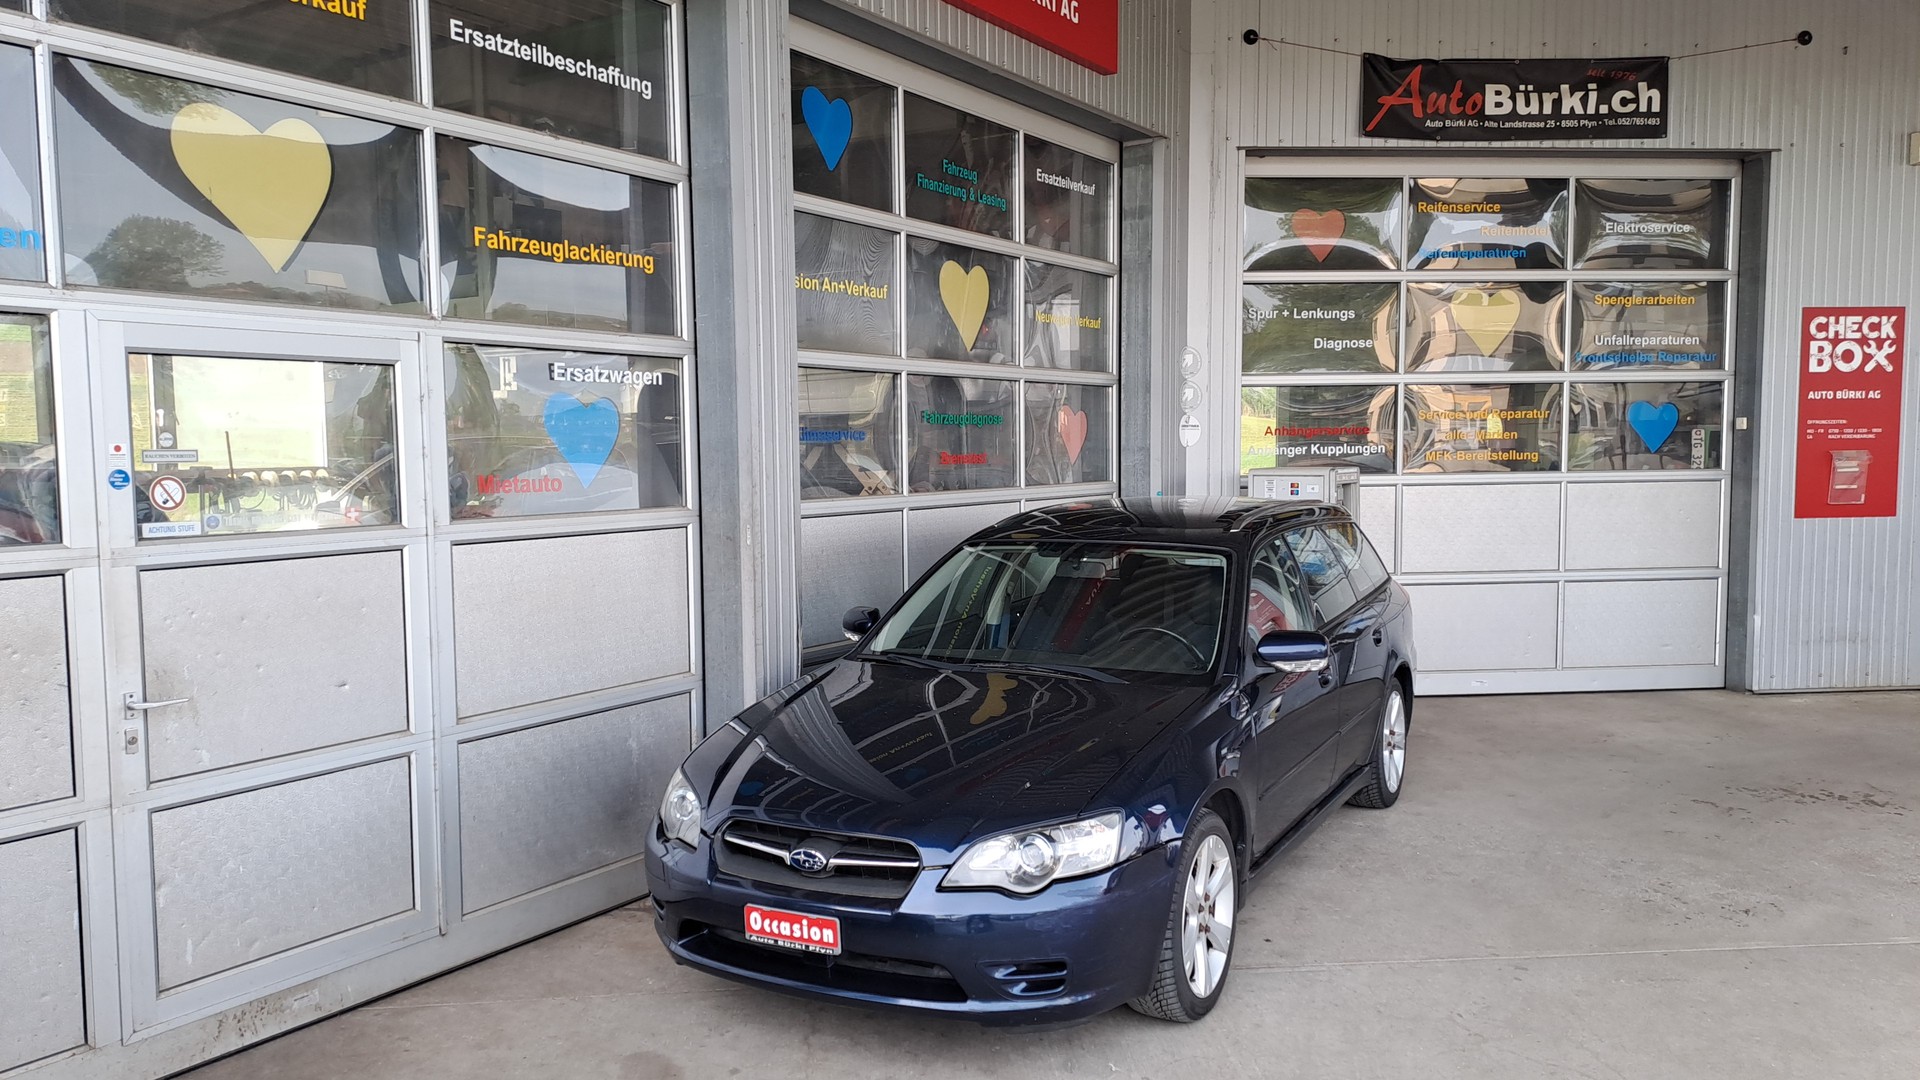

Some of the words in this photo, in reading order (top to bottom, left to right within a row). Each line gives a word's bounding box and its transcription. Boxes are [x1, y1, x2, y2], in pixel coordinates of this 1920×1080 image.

[1060, 0, 1079, 24] AG
[450, 18, 652, 100] Ersatzteilbeschaffung
[1610, 70, 1638, 81] 1976
[1425, 119, 1444, 128] Auto
[1445, 119, 1466, 128] Bürki
[1467, 119, 1479, 128] AG
[1484, 120, 1499, 128] Alte
[1500, 120, 1545, 129] Landstrasse
[1546, 120, 1555, 128] 25
[1561, 120, 1579, 128] 8505
[1580, 119, 1598, 129] Pfyn
[943, 158, 978, 185] Fahrzeug
[1036, 168, 1096, 196] Ersatzteilverkauf
[917, 173, 967, 202] Finanzierung
[969, 189, 975, 202] &
[978, 191, 1006, 212] Leasing
[1417, 202, 1501, 213] Reifenservice
[1605, 222, 1690, 233] Elektroservice
[473, 226, 655, 275] Fahrzeuglackierung
[822, 277, 888, 299] An+Verkauf
[1594, 294, 1695, 307] Spenglerarbeiten
[1248, 308, 1278, 321] Spur
[1282, 309, 1290, 318] +
[1293, 308, 1355, 321] Lenkungs
[1808, 315, 1898, 339] CHECK
[1314, 338, 1373, 351] Diagnose
[1595, 335, 1700, 347] Unfallreparaturen
[1658, 351, 1717, 363] Reparatur
[1808, 340, 1897, 373] BOX
[551, 362, 662, 391] Ersatzwagen
[1807, 390, 1834, 400] AUTO
[1836, 389, 1866, 400] BÜRKI
[1867, 390, 1881, 399] AG
[922, 410, 1003, 428] Fahrzeugdiagnose
[1418, 410, 1461, 420] Service
[1466, 409, 1488, 419] und
[1491, 409, 1550, 421] Reparatur
[1264, 425, 1370, 439] Anhängerservice
[1311, 443, 1386, 456] Kupplungen
[1425, 449, 1539, 462] MFK-Bereitstellung
[477, 473, 563, 495] Mietauto
[148, 526, 177, 534] ACHTUNG
[749, 910, 835, 944] Occasion
[750, 935, 775, 944] Auto
